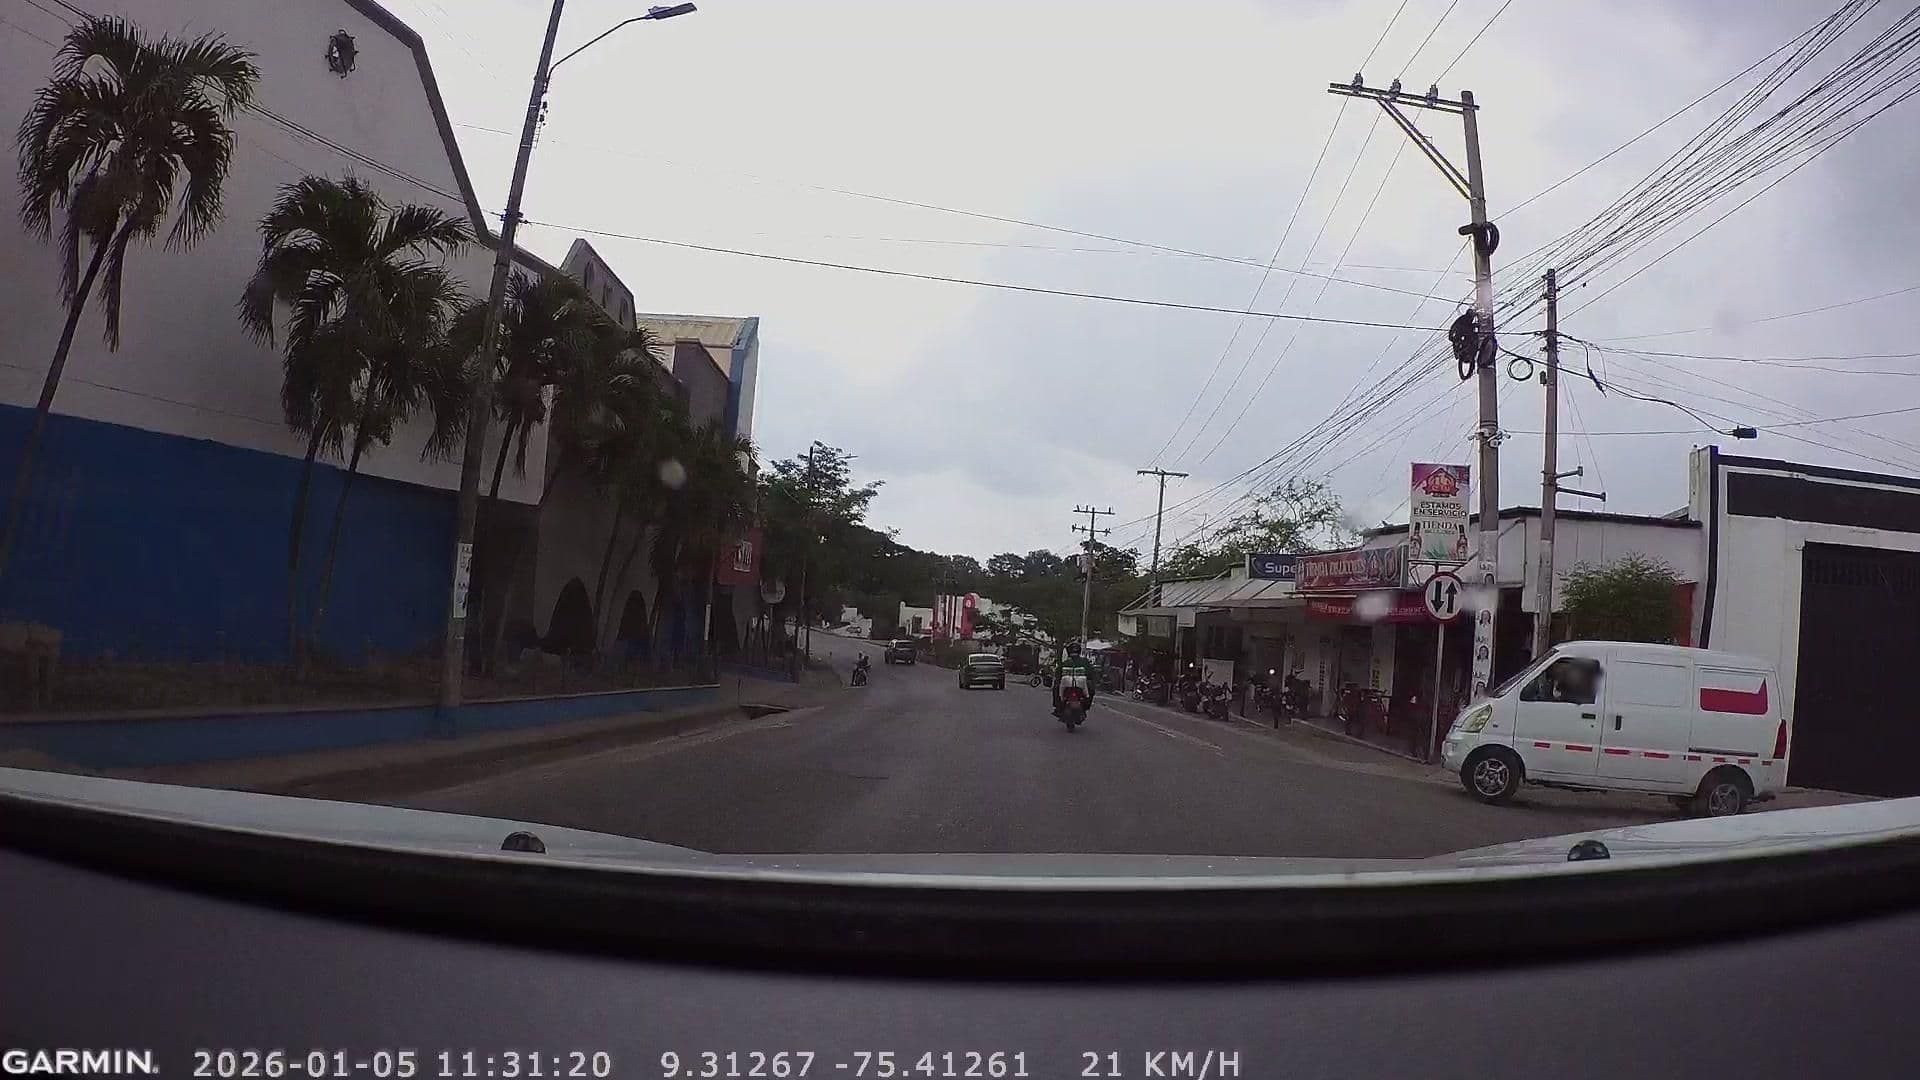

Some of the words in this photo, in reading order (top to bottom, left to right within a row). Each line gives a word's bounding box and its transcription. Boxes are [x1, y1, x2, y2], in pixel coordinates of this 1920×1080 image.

[1421, 501, 1461, 509] ESTAMOS
[1427, 509, 1467, 517] SERVICIO
[1423, 520, 1458, 530] TIENDA
